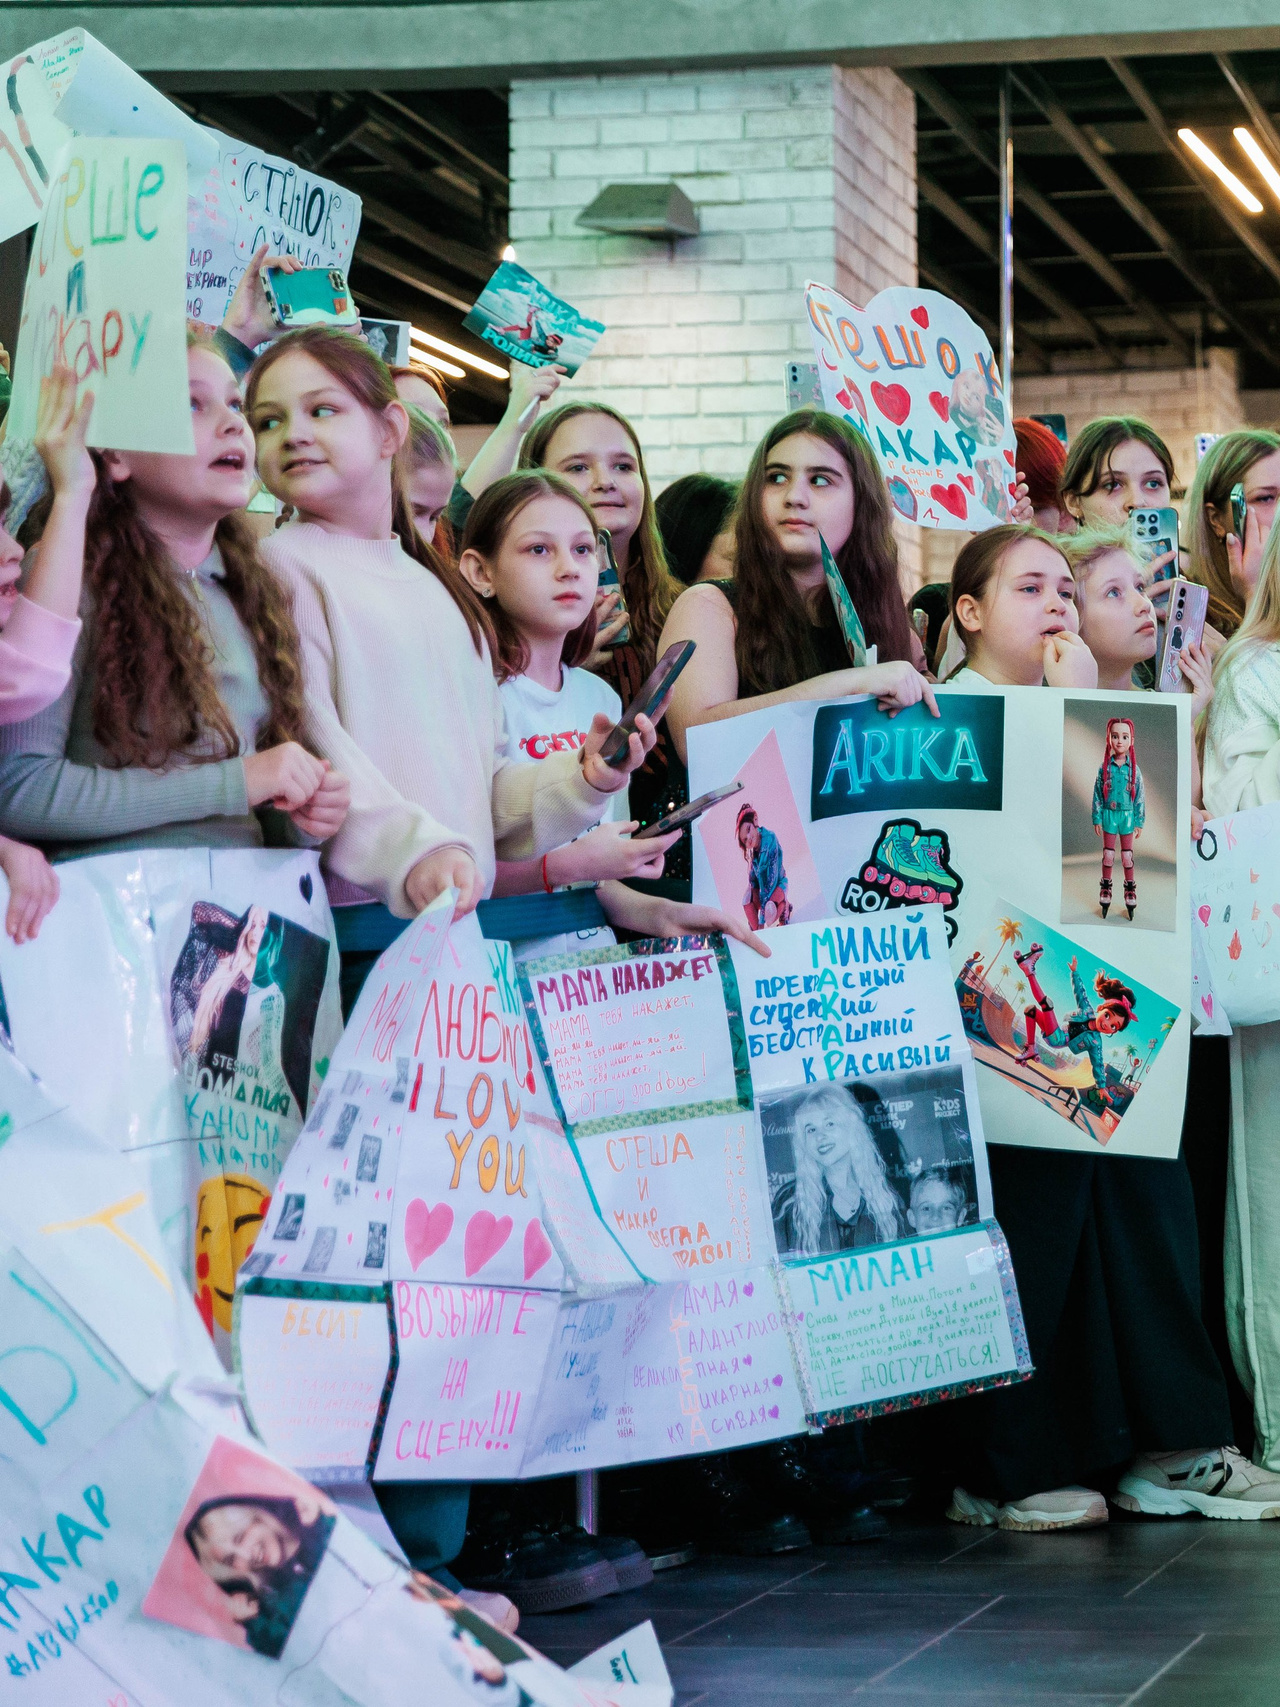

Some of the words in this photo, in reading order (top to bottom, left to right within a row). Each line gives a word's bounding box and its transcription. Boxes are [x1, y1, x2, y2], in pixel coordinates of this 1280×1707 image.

[819, 718, 988, 796] ARIKA
[811, 912, 931, 968] МИЛЫЙ
[537, 968, 608, 1016] МАМА
[612, 954, 714, 995] НАКАЖЕТ
[549, 1013, 591, 1042] МАМА
[434, 1066, 521, 1132] LOV
[445, 1129, 529, 1199] YOU
[606, 1132, 694, 1173] СТЕША
[807, 1246, 935, 1306] МИЛАН
[282, 1302, 362, 1339] БЕСИТ
[397, 1281, 542, 1339] ВОЗЬМИТЕ
[440, 1357, 468, 1400] НА
